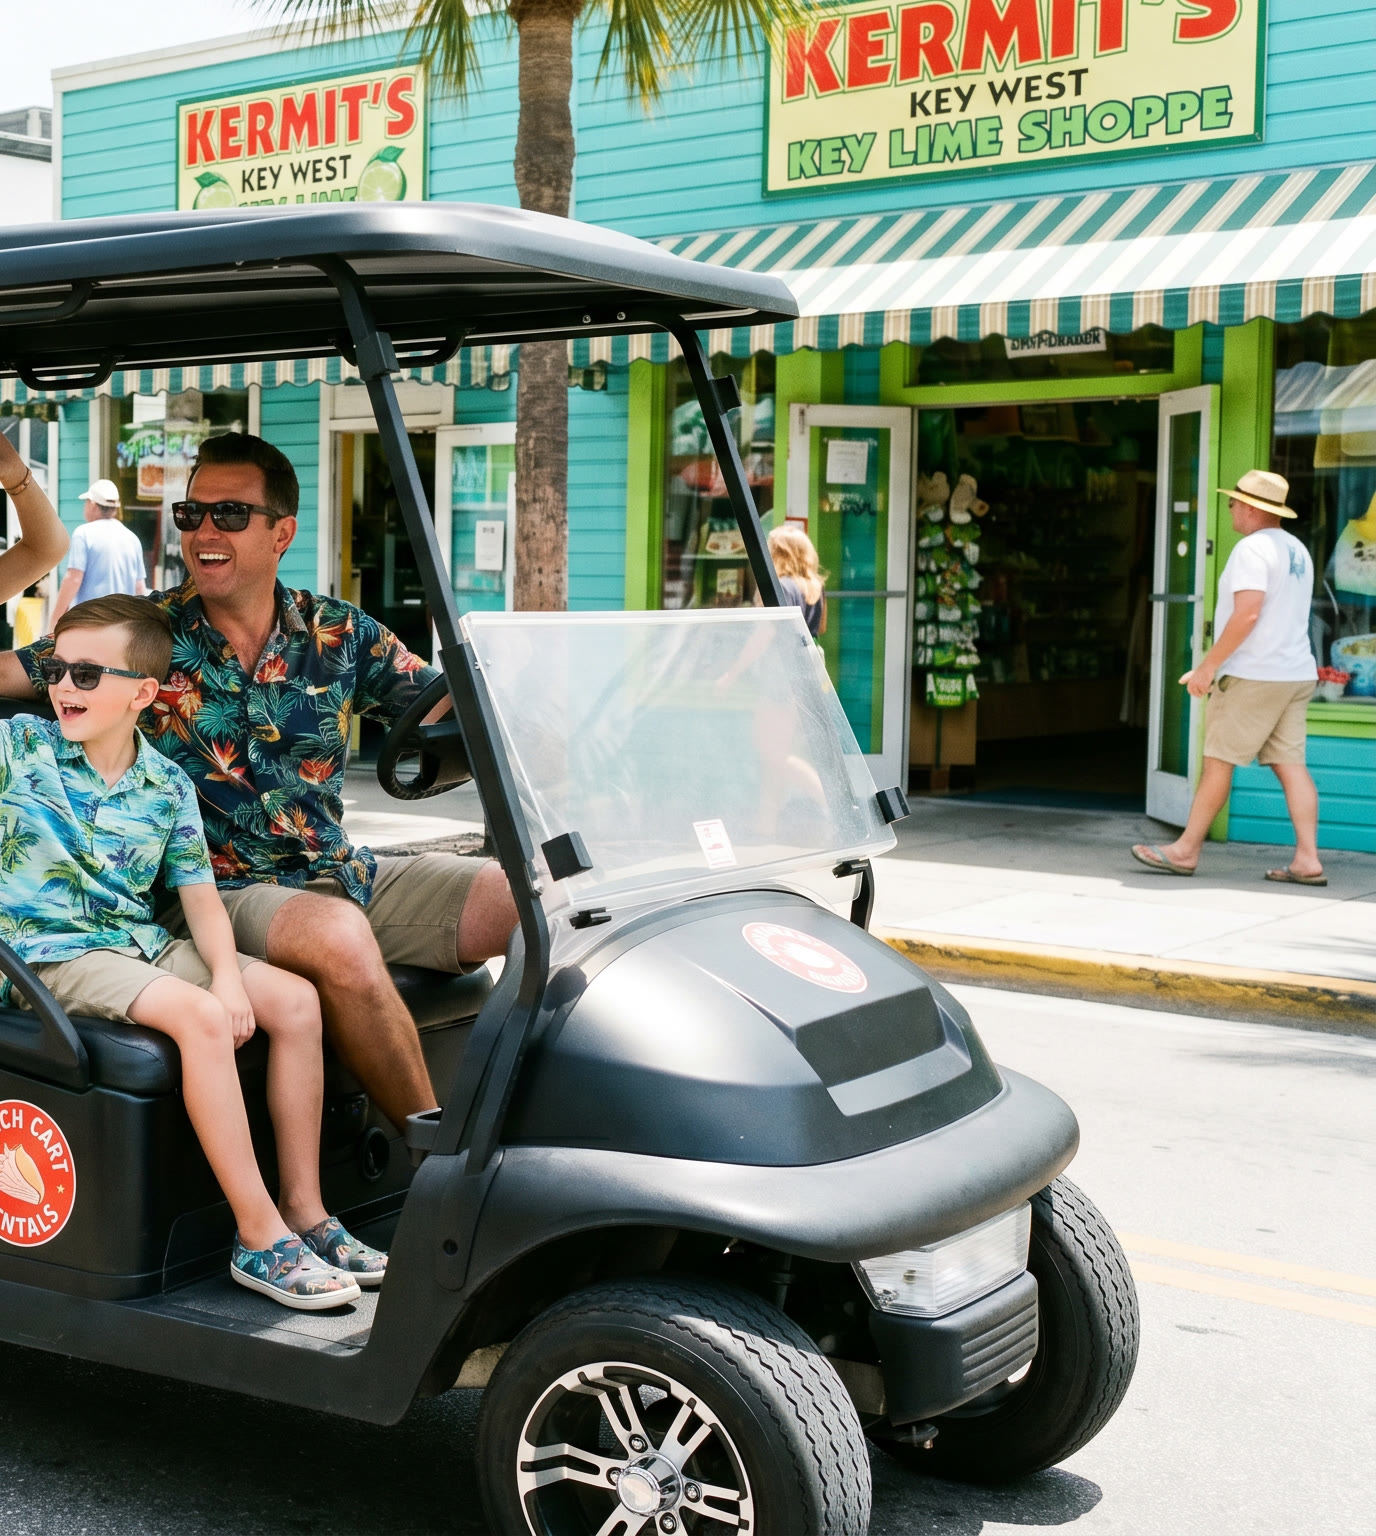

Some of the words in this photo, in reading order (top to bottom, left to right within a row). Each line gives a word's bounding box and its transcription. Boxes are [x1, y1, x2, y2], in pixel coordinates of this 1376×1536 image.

[785, 0, 1238, 99] KERMIT
[185, 76, 416, 166] KERMIT'S
[910, 84, 976, 118] KEY
[988, 68, 1089, 107] WEST
[787, 132, 877, 181] KEY
[889, 115, 1003, 169] LIME
[1018, 85, 1233, 153] SHOPPE
[240, 164, 283, 194] KEY
[290, 154, 352, 185] WEST
[30, 1116, 69, 1173] CART
